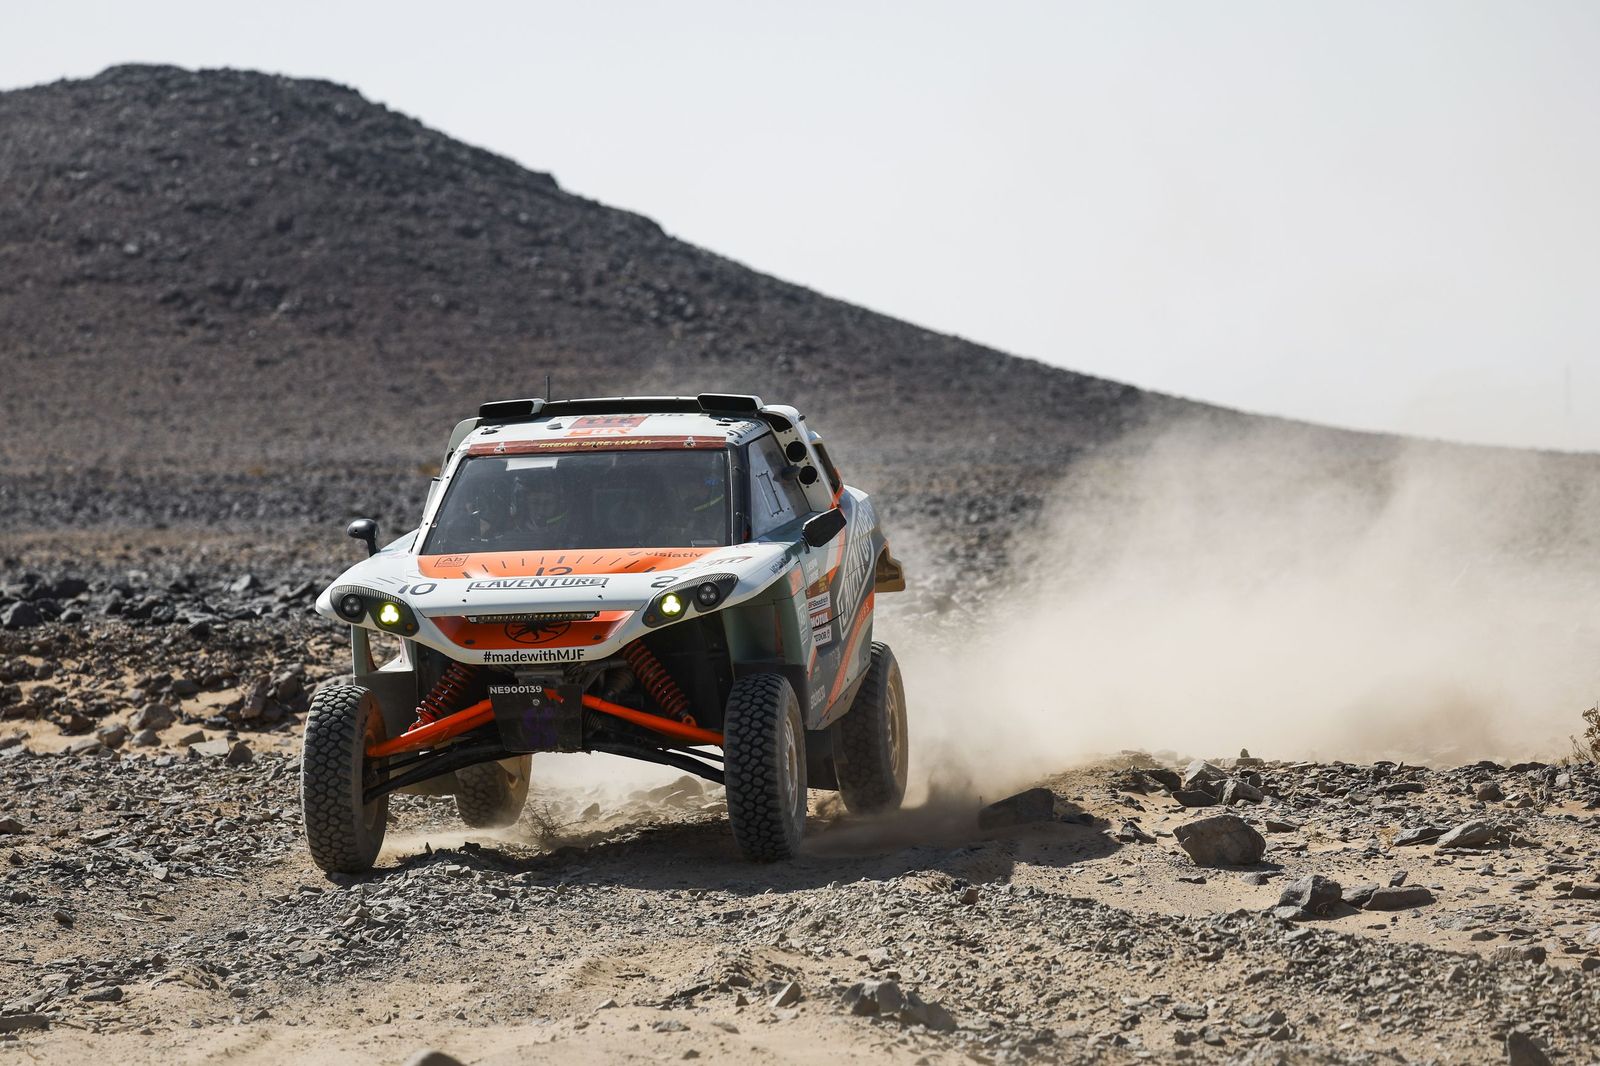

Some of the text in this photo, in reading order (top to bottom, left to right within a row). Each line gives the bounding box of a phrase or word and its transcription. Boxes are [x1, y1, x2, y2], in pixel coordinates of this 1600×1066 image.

[535, 566, 573, 577] 12
[651, 575, 679, 588] 2
[398, 583, 438, 596] 10
[483, 649, 585, 663] #madewithMJF
[489, 685, 543, 695] NE900139
